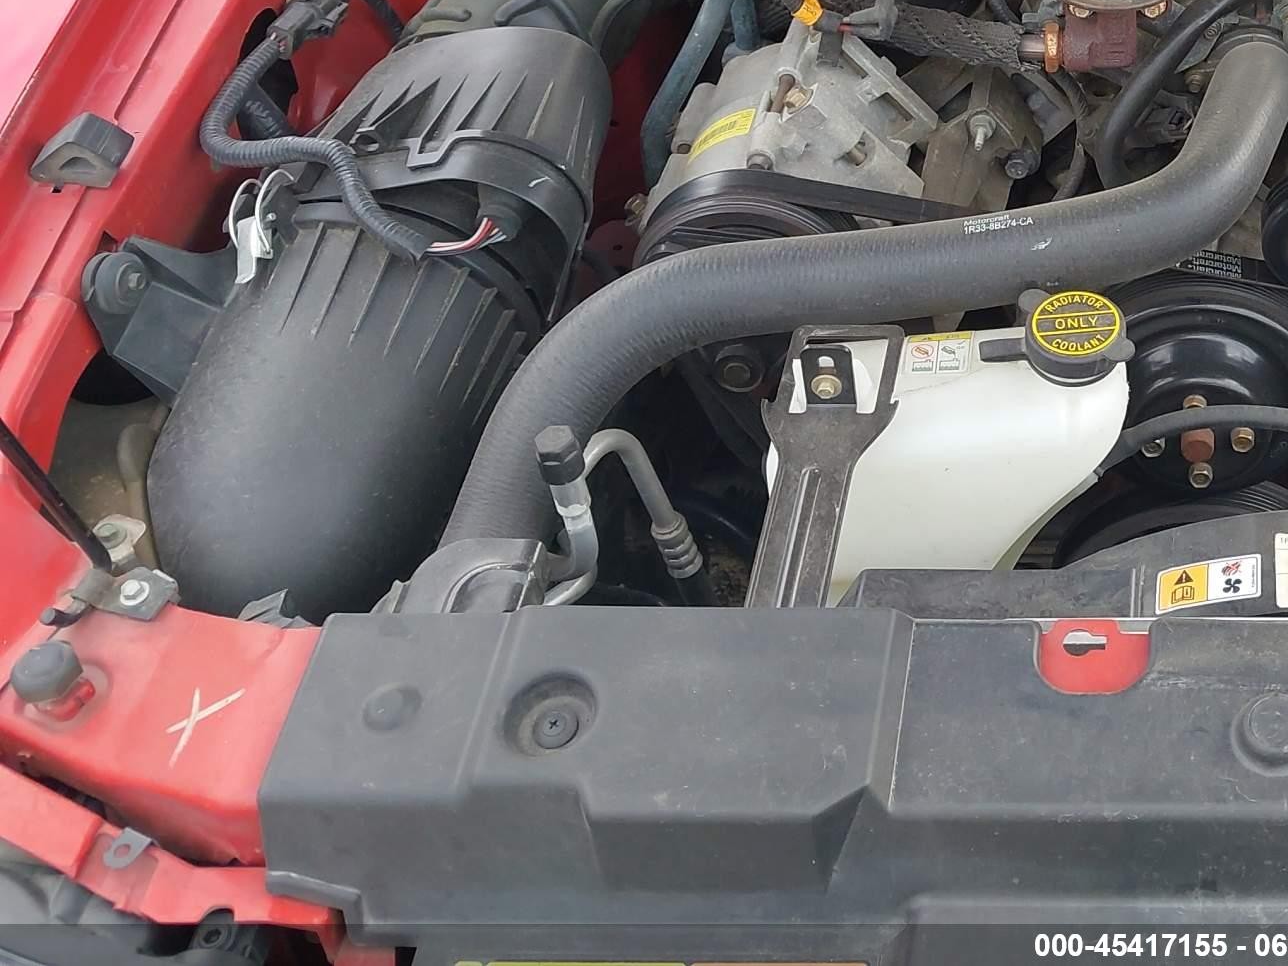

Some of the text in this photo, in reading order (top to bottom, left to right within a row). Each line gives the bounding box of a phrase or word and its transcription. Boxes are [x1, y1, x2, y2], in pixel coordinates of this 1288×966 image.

[964, 214, 1009, 226] Motorcraft
[1044, 294, 1104, 314] RADIATOR
[1055, 315, 1099, 330] ONLY
[1052, 333, 1106, 351] COOLANT
